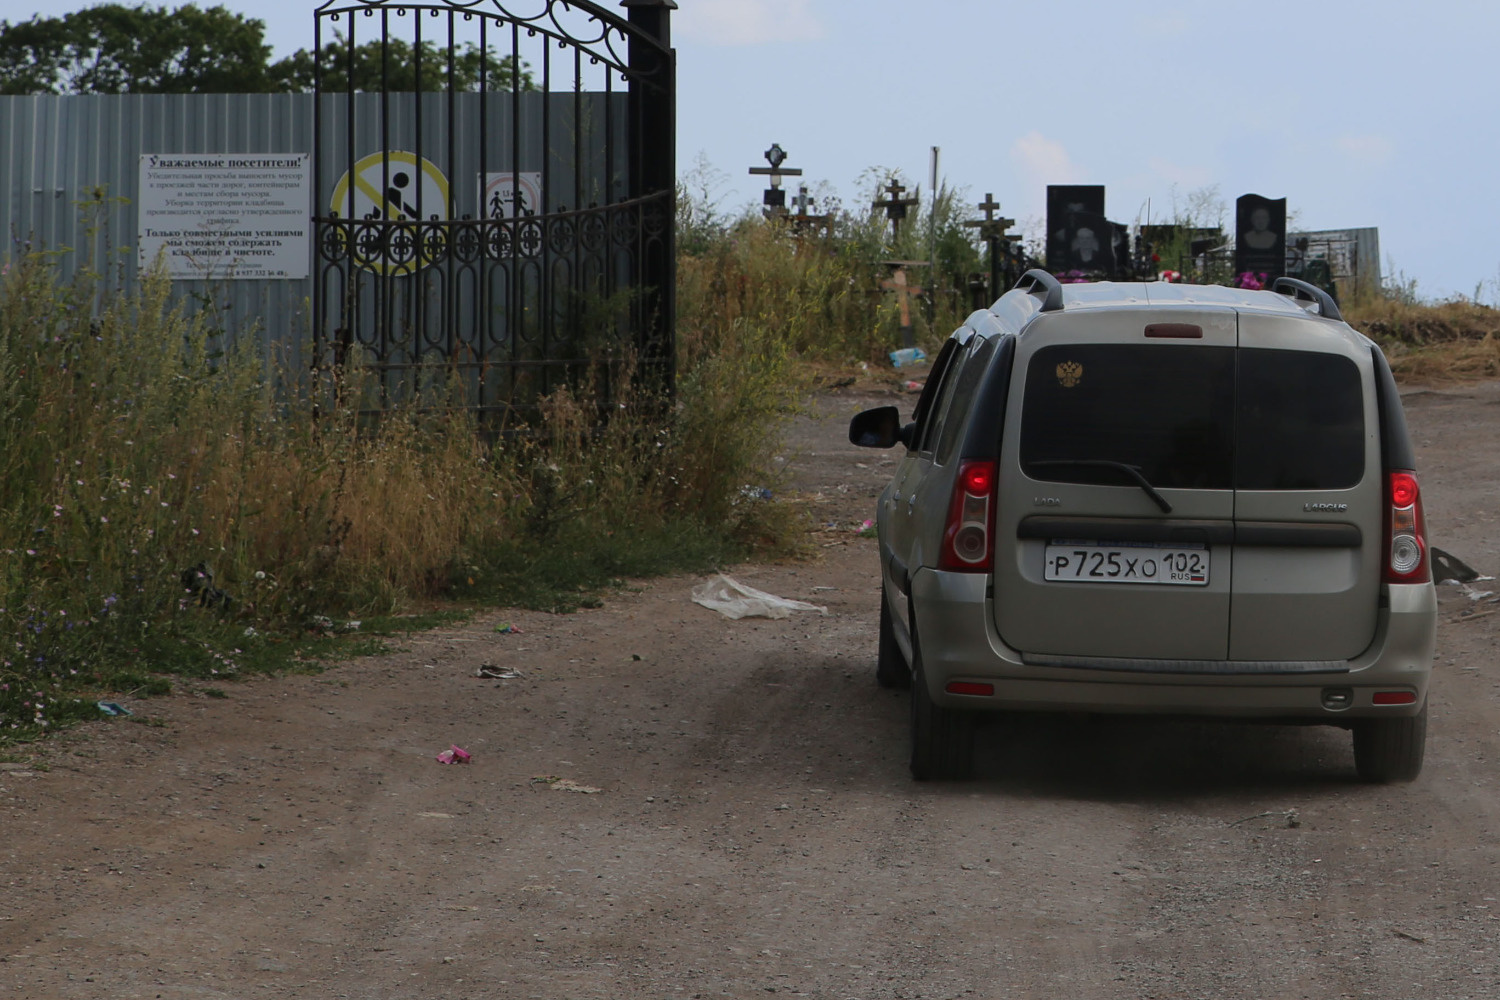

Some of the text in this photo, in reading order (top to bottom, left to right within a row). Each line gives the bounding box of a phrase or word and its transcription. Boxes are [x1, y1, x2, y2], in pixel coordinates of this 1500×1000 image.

[150, 155, 301, 168] Уважаемые посетители!
[204, 172, 236, 180] просьба
[215, 190, 239, 198] сбора
[165, 199, 194, 207] Уборка
[145, 228, 303, 239] Только совместными усилиями
[228, 240, 282, 248] содержать
[1033, 496, 1061, 507] LADA
[1302, 503, 1348, 513] LARGUS
[1170, 572, 1190, 581] RUS
